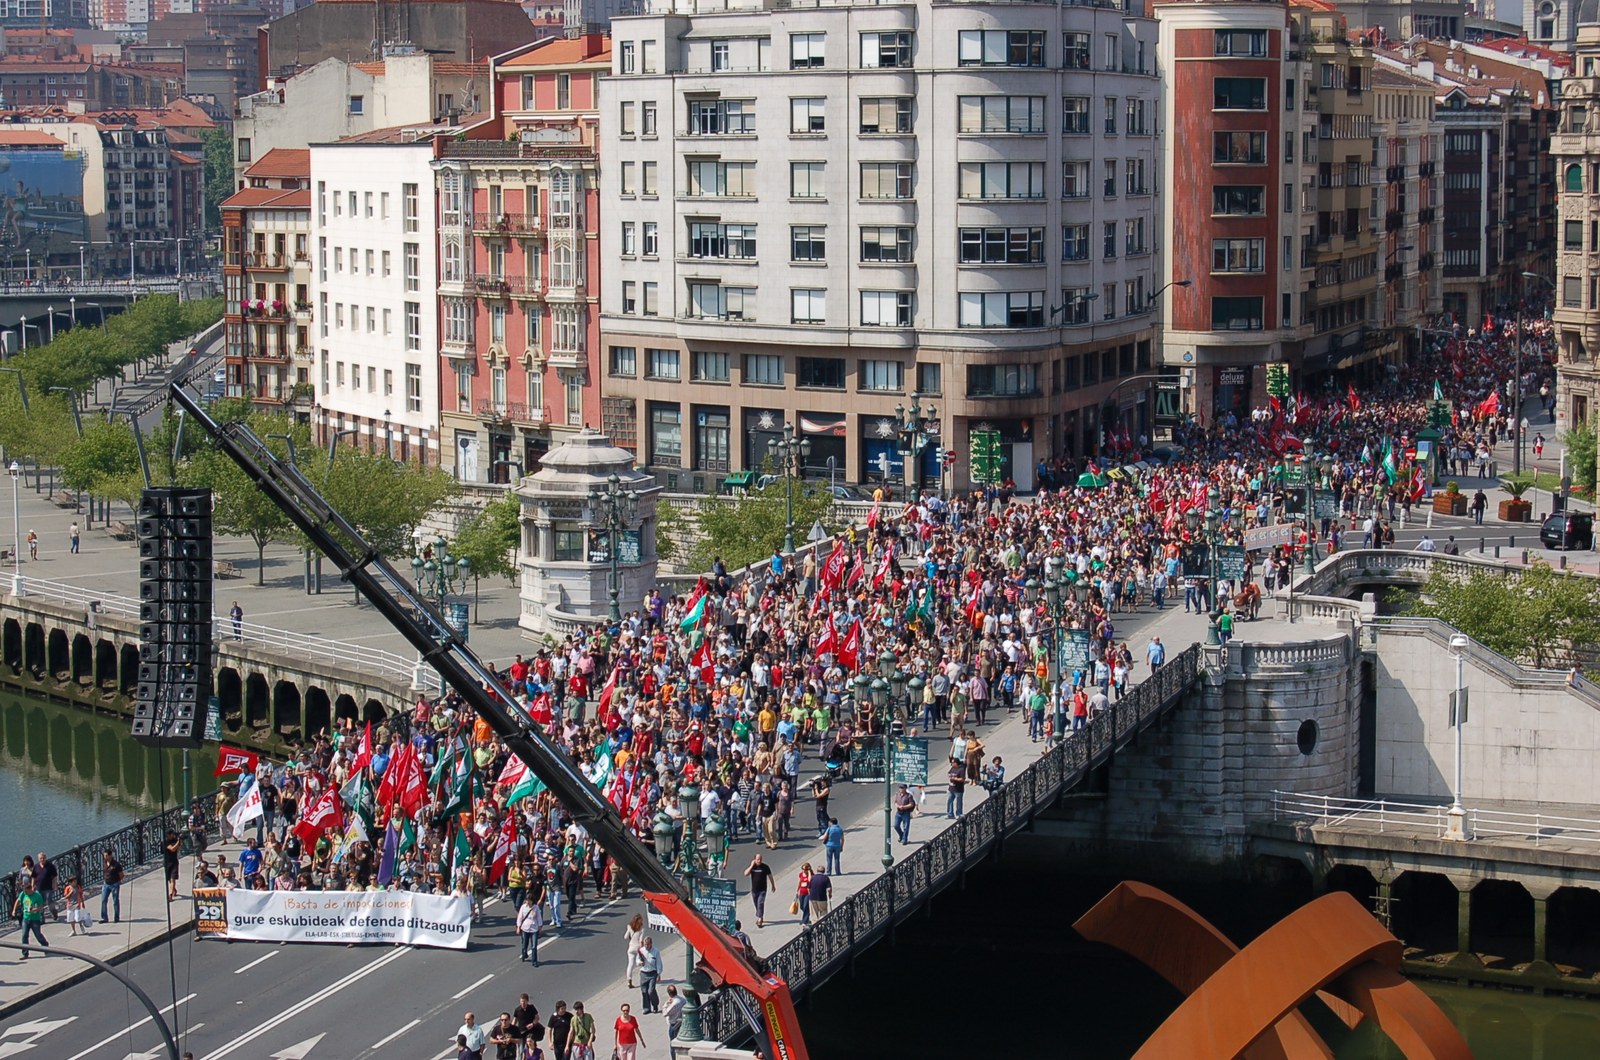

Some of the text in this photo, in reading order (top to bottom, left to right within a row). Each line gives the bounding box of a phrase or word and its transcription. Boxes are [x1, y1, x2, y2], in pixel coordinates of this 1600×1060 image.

[198, 905, 221, 920] 29
[283, 897, 414, 913] ¡Basta de imposiciones!
[234, 915, 265, 927] gure
[269, 914, 345, 927] eskubideak
